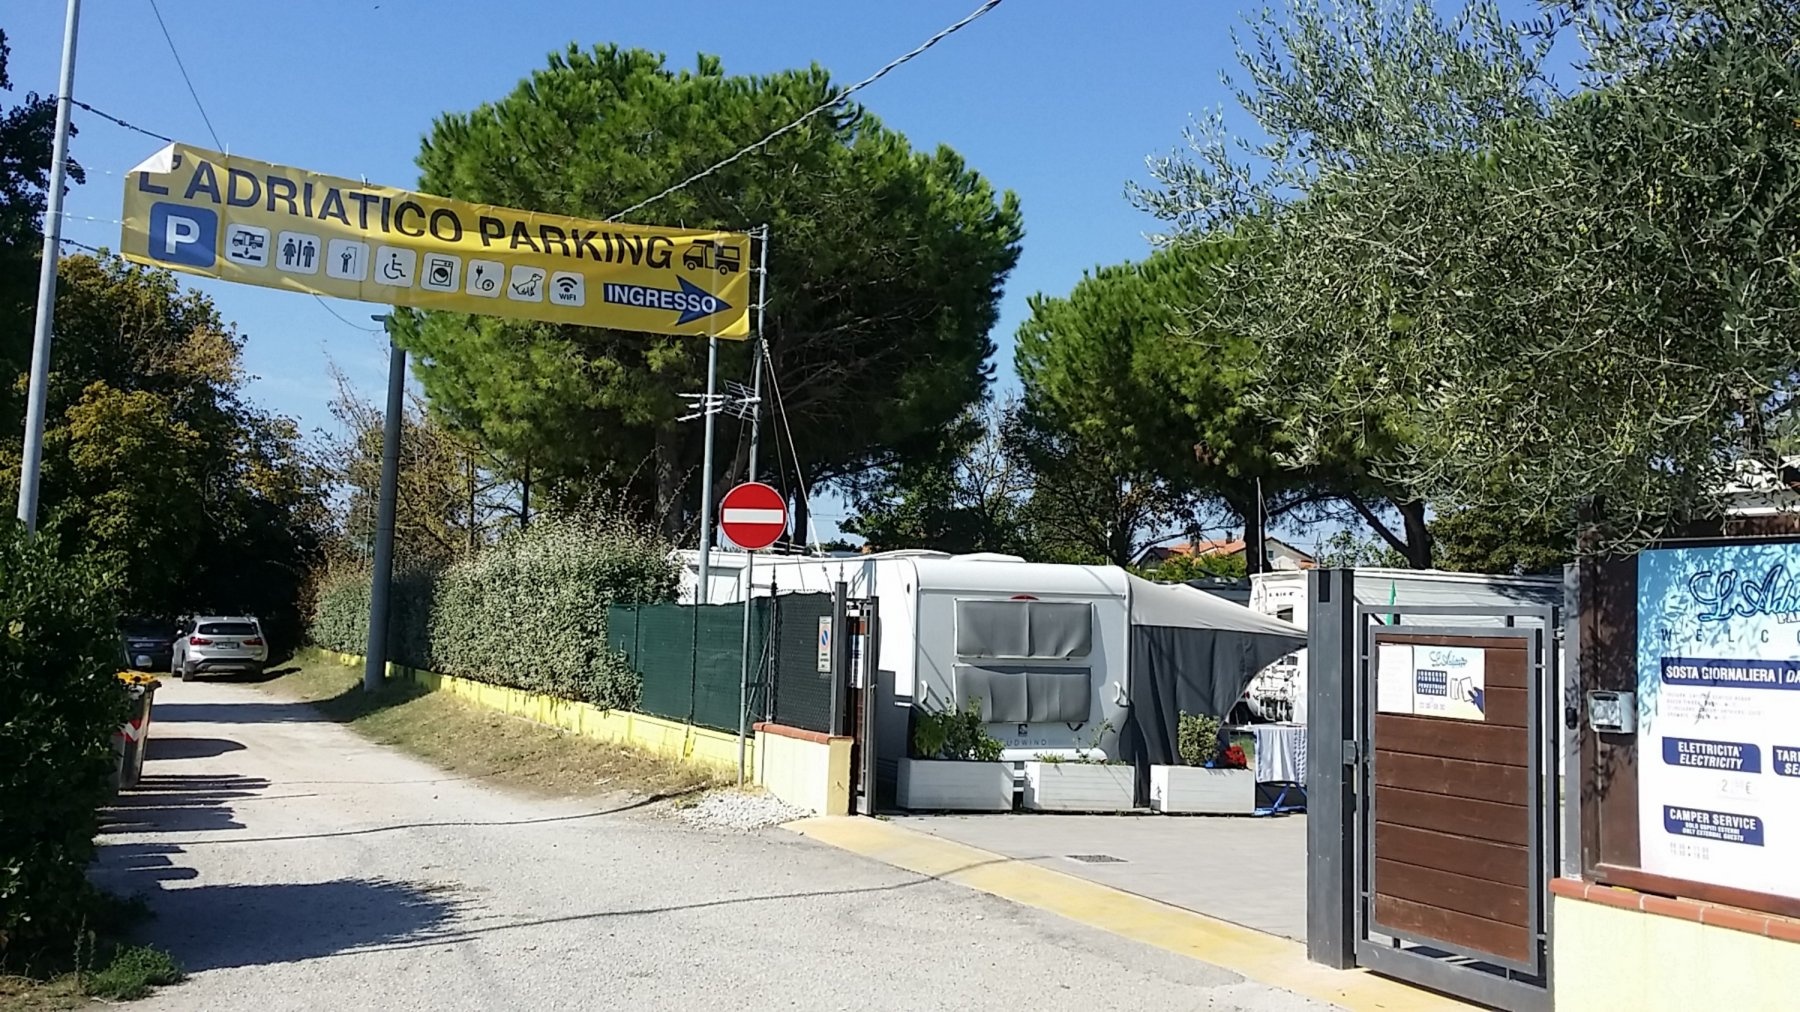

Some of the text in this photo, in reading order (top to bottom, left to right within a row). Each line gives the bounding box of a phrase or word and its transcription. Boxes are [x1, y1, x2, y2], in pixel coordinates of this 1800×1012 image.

[139, 154, 675, 270] L'ADRIATICO PARKING
[165, 215, 200, 255] P
[559, 292, 577, 302] WIFI
[607, 284, 718, 314] INGRESSO
[1775, 611, 1800, 625] PA
[1665, 665, 1699, 680] SOSTA
[1701, 666, 1776, 682] GIORNALIERA
[1003, 738, 1047, 747] UDWIND
[1679, 753, 1744, 770] ELECTRICITY
[1669, 808, 1757, 830] CAMPER SERVICE
